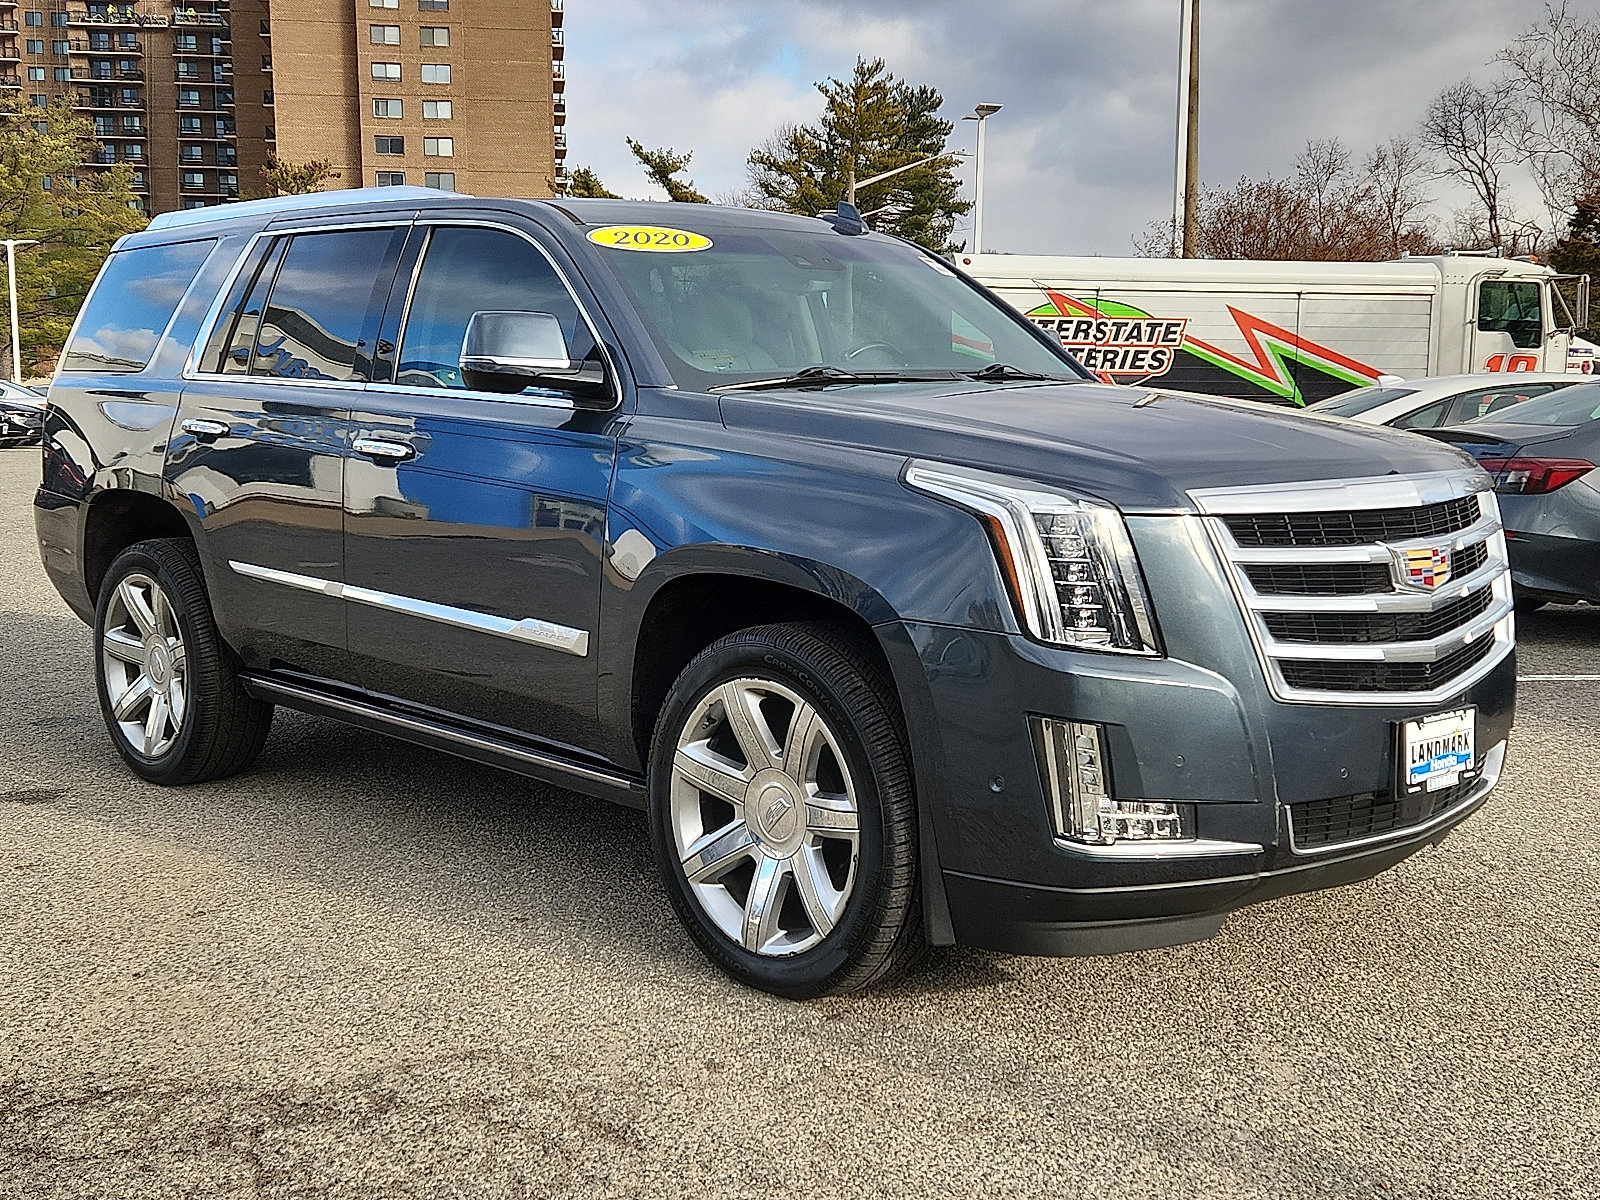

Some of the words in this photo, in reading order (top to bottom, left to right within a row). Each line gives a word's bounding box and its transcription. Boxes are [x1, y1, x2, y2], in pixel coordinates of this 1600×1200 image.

[613, 231, 690, 246] 2020
[1031, 319, 1181, 343] TERSTATE
[1411, 732, 1470, 764] LANDMARK
[1430, 754, 1458, 772] Honda
